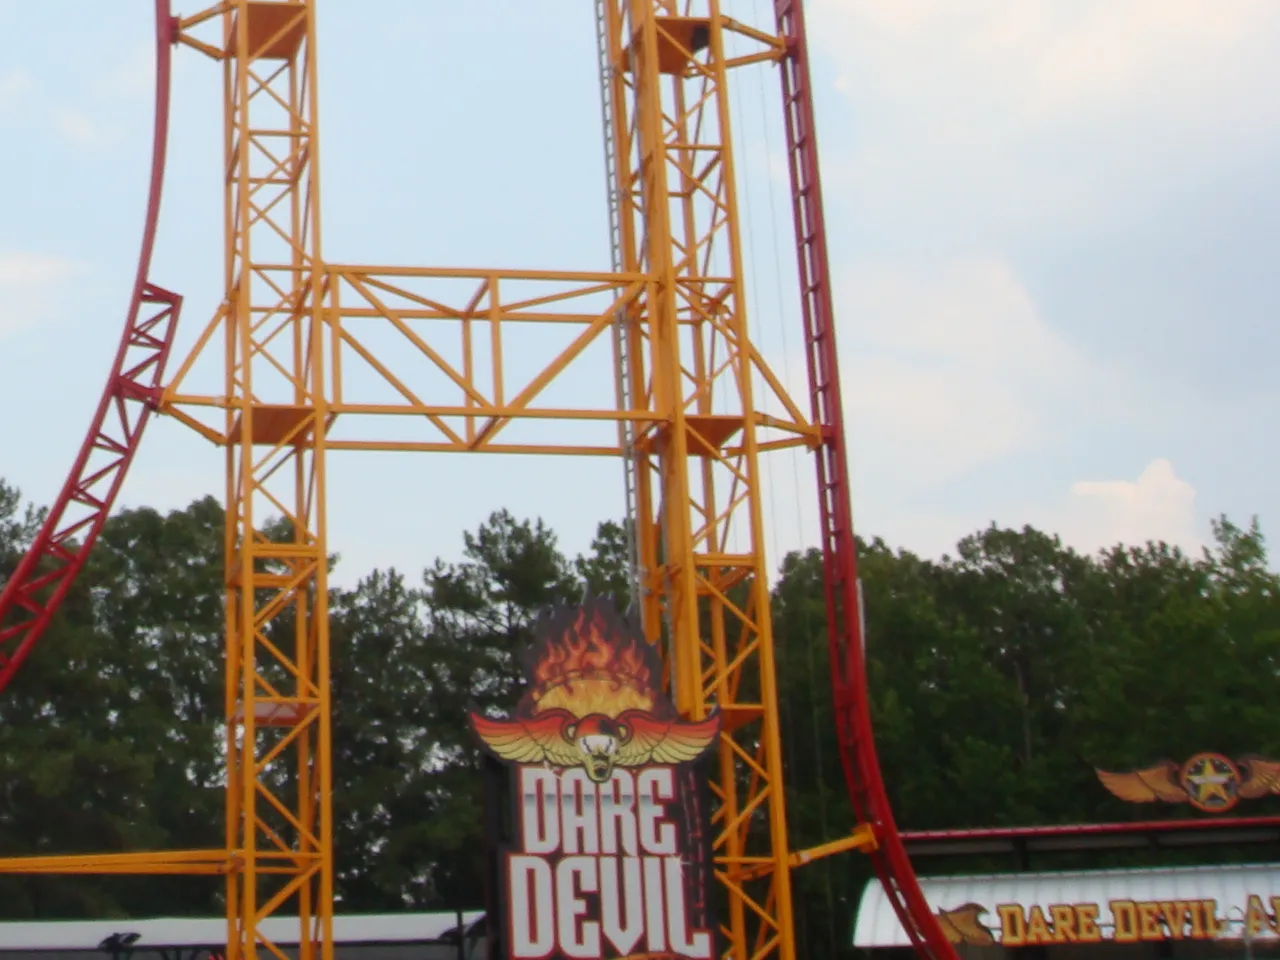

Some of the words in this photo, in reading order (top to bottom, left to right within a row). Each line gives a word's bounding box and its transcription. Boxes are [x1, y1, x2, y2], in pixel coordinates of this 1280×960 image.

[519, 766, 679, 856] DARE
[507, 854, 712, 959] DEVIL
[997, 903, 1102, 946] DARE
[1109, 898, 1228, 942] DEVIL
